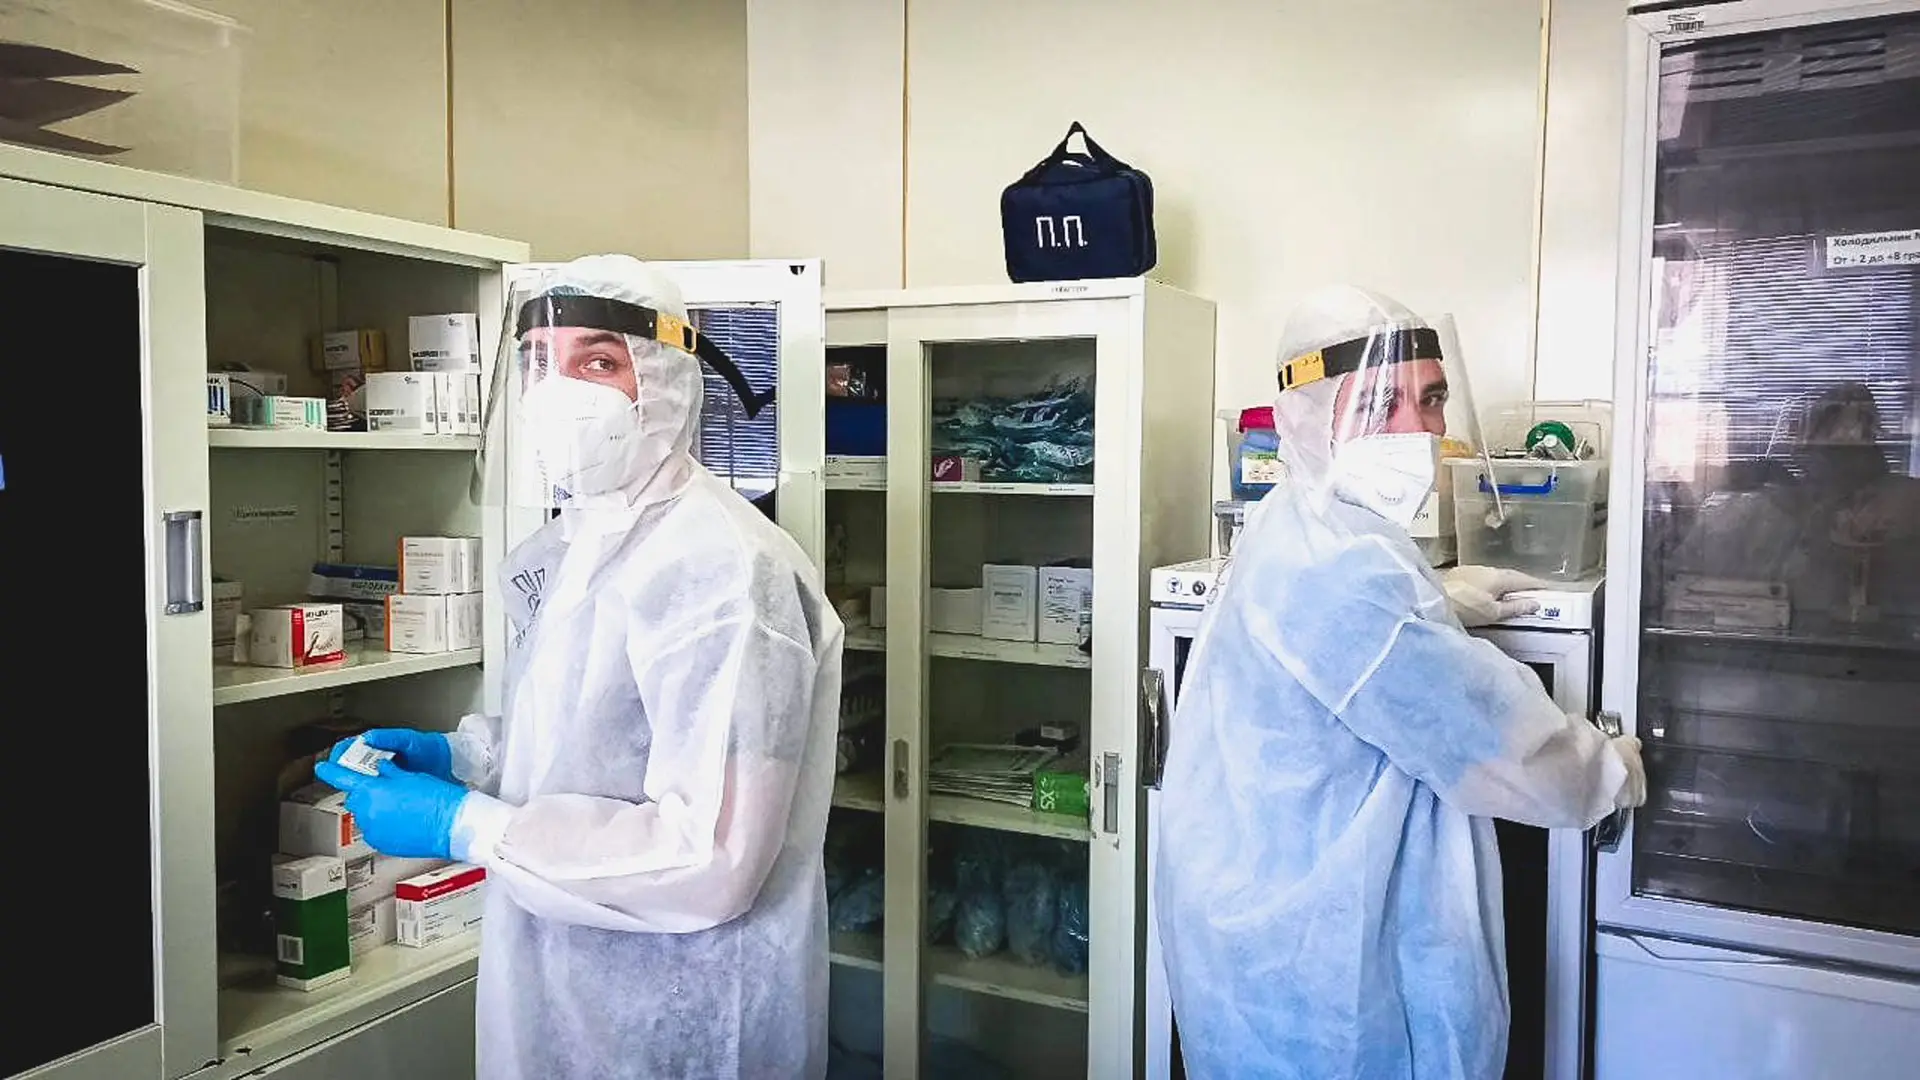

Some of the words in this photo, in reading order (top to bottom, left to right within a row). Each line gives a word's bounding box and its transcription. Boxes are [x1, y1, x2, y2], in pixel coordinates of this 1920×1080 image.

[1036, 215, 1088, 248] П.П.
[1833, 235, 1912, 247] Холодильник
[1833, 256, 1848, 265] От
[1867, 255, 1884, 264] до
